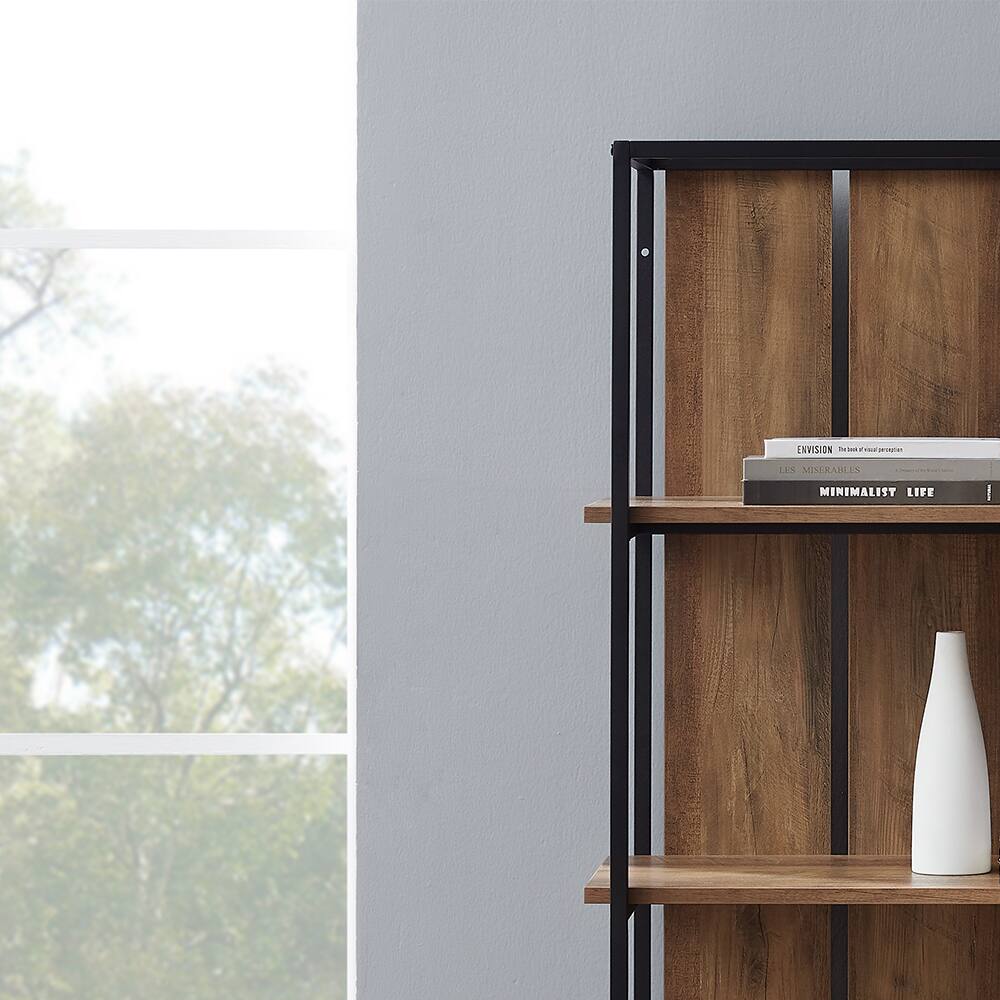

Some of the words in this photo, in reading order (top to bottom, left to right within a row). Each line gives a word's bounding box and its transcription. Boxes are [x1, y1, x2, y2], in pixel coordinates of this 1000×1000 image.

[797, 445, 833, 455] ENVISION
[778, 466, 796, 475] LES
[819, 486, 897, 497] MINIMALIST
[906, 487, 935, 497] LIFE
